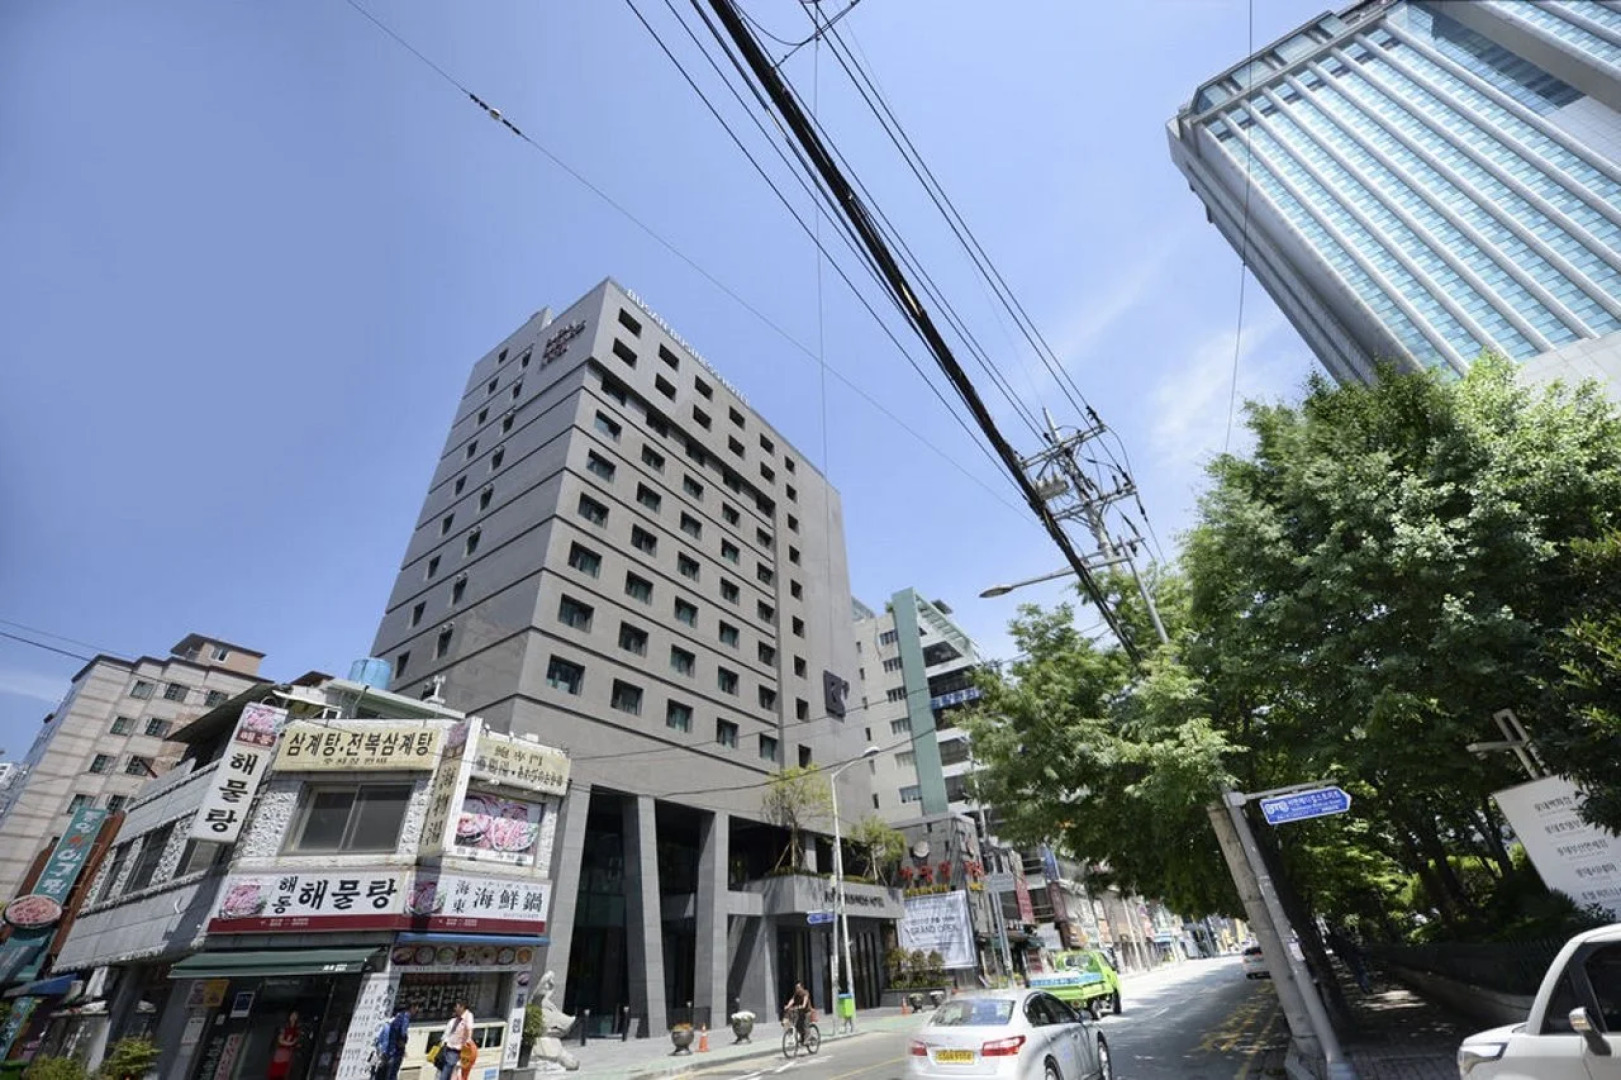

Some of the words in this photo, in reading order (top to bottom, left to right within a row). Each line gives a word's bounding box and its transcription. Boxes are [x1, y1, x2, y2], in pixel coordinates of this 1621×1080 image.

[203, 751, 259, 834] 해물탕
[270, 875, 299, 914] 해동
[298, 877, 397, 910] 해물탕
[473, 886, 543, 913] 海鮮鍋
